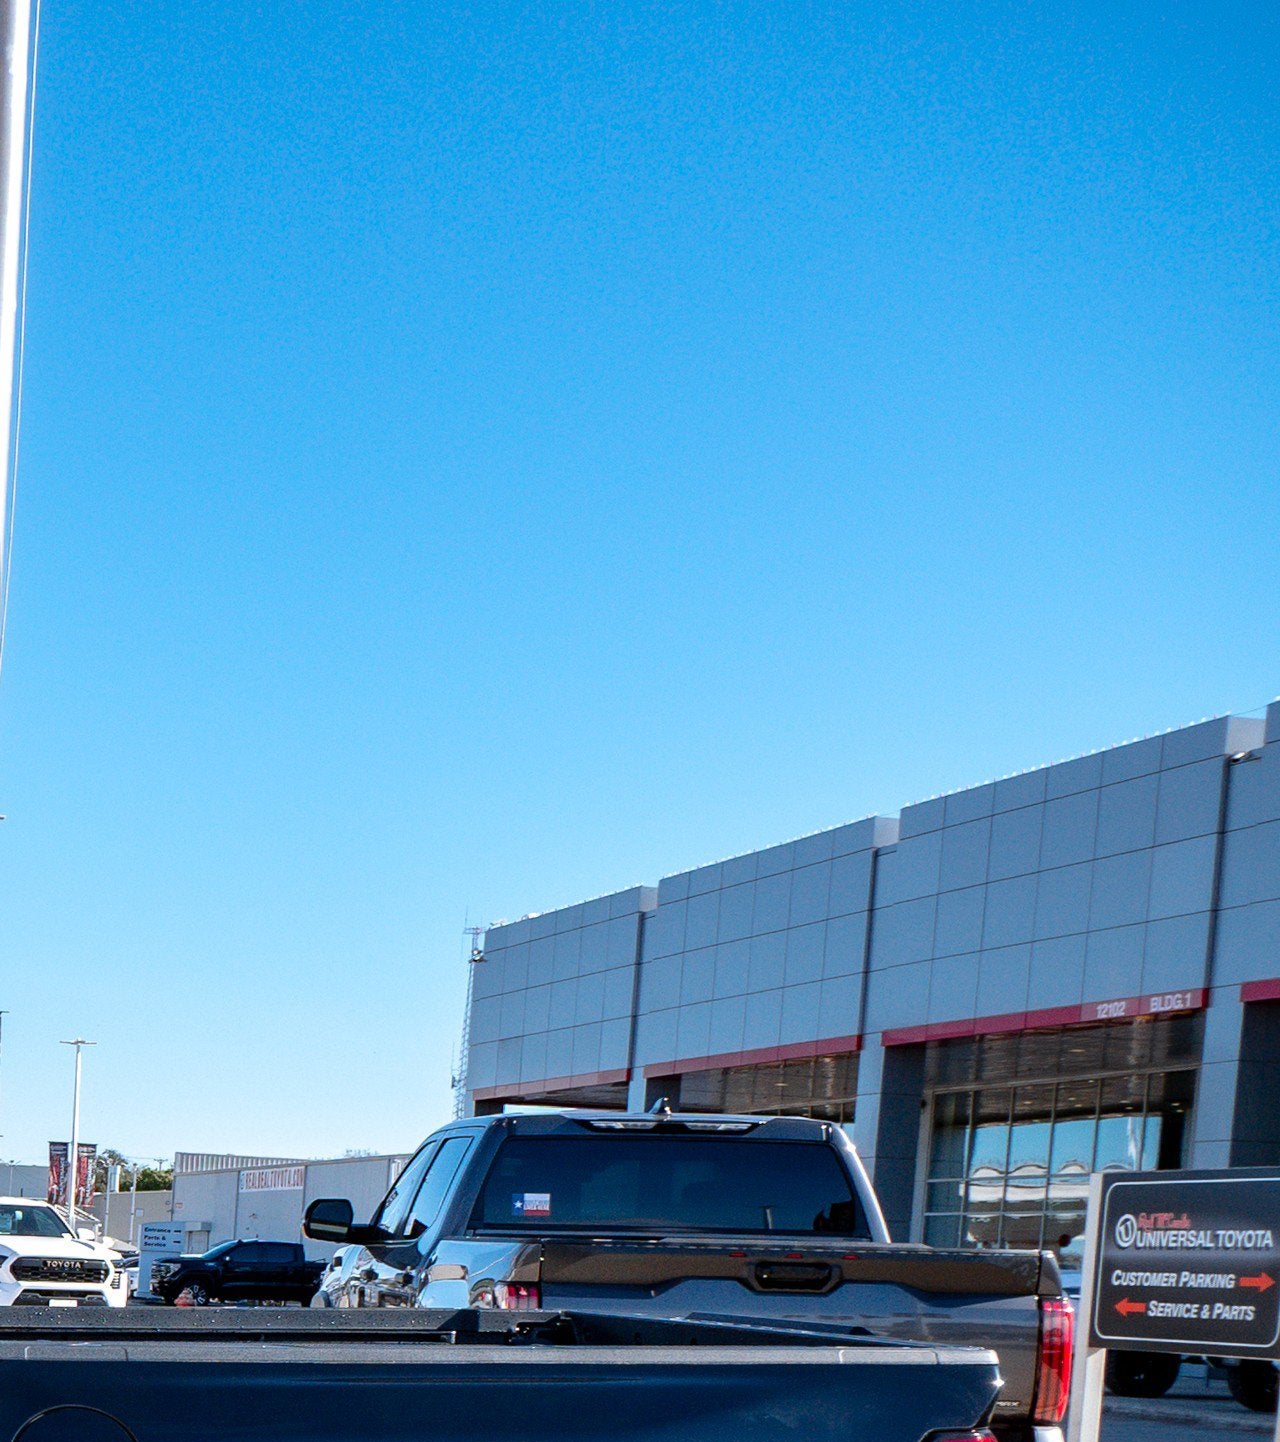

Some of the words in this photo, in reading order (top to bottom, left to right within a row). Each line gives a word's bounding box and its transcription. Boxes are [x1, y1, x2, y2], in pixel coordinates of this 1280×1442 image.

[1096, 1002, 1126, 1018] 12102
[1184, 992, 1192, 1008] 1
[1136, 1230, 1215, 1248] UNIVERSAL
[1217, 1230, 1273, 1248] TOYOTA
[46, 1260, 82, 1269] TOYOTA
[1111, 1270, 1178, 1288] CUSTOMER
[1178, 1271, 1236, 1289] PARKING
[1147, 1300, 1200, 1318] SERVICE
[1200, 1303, 1211, 1319] &
[1211, 1303, 1257, 1322] PARTS
